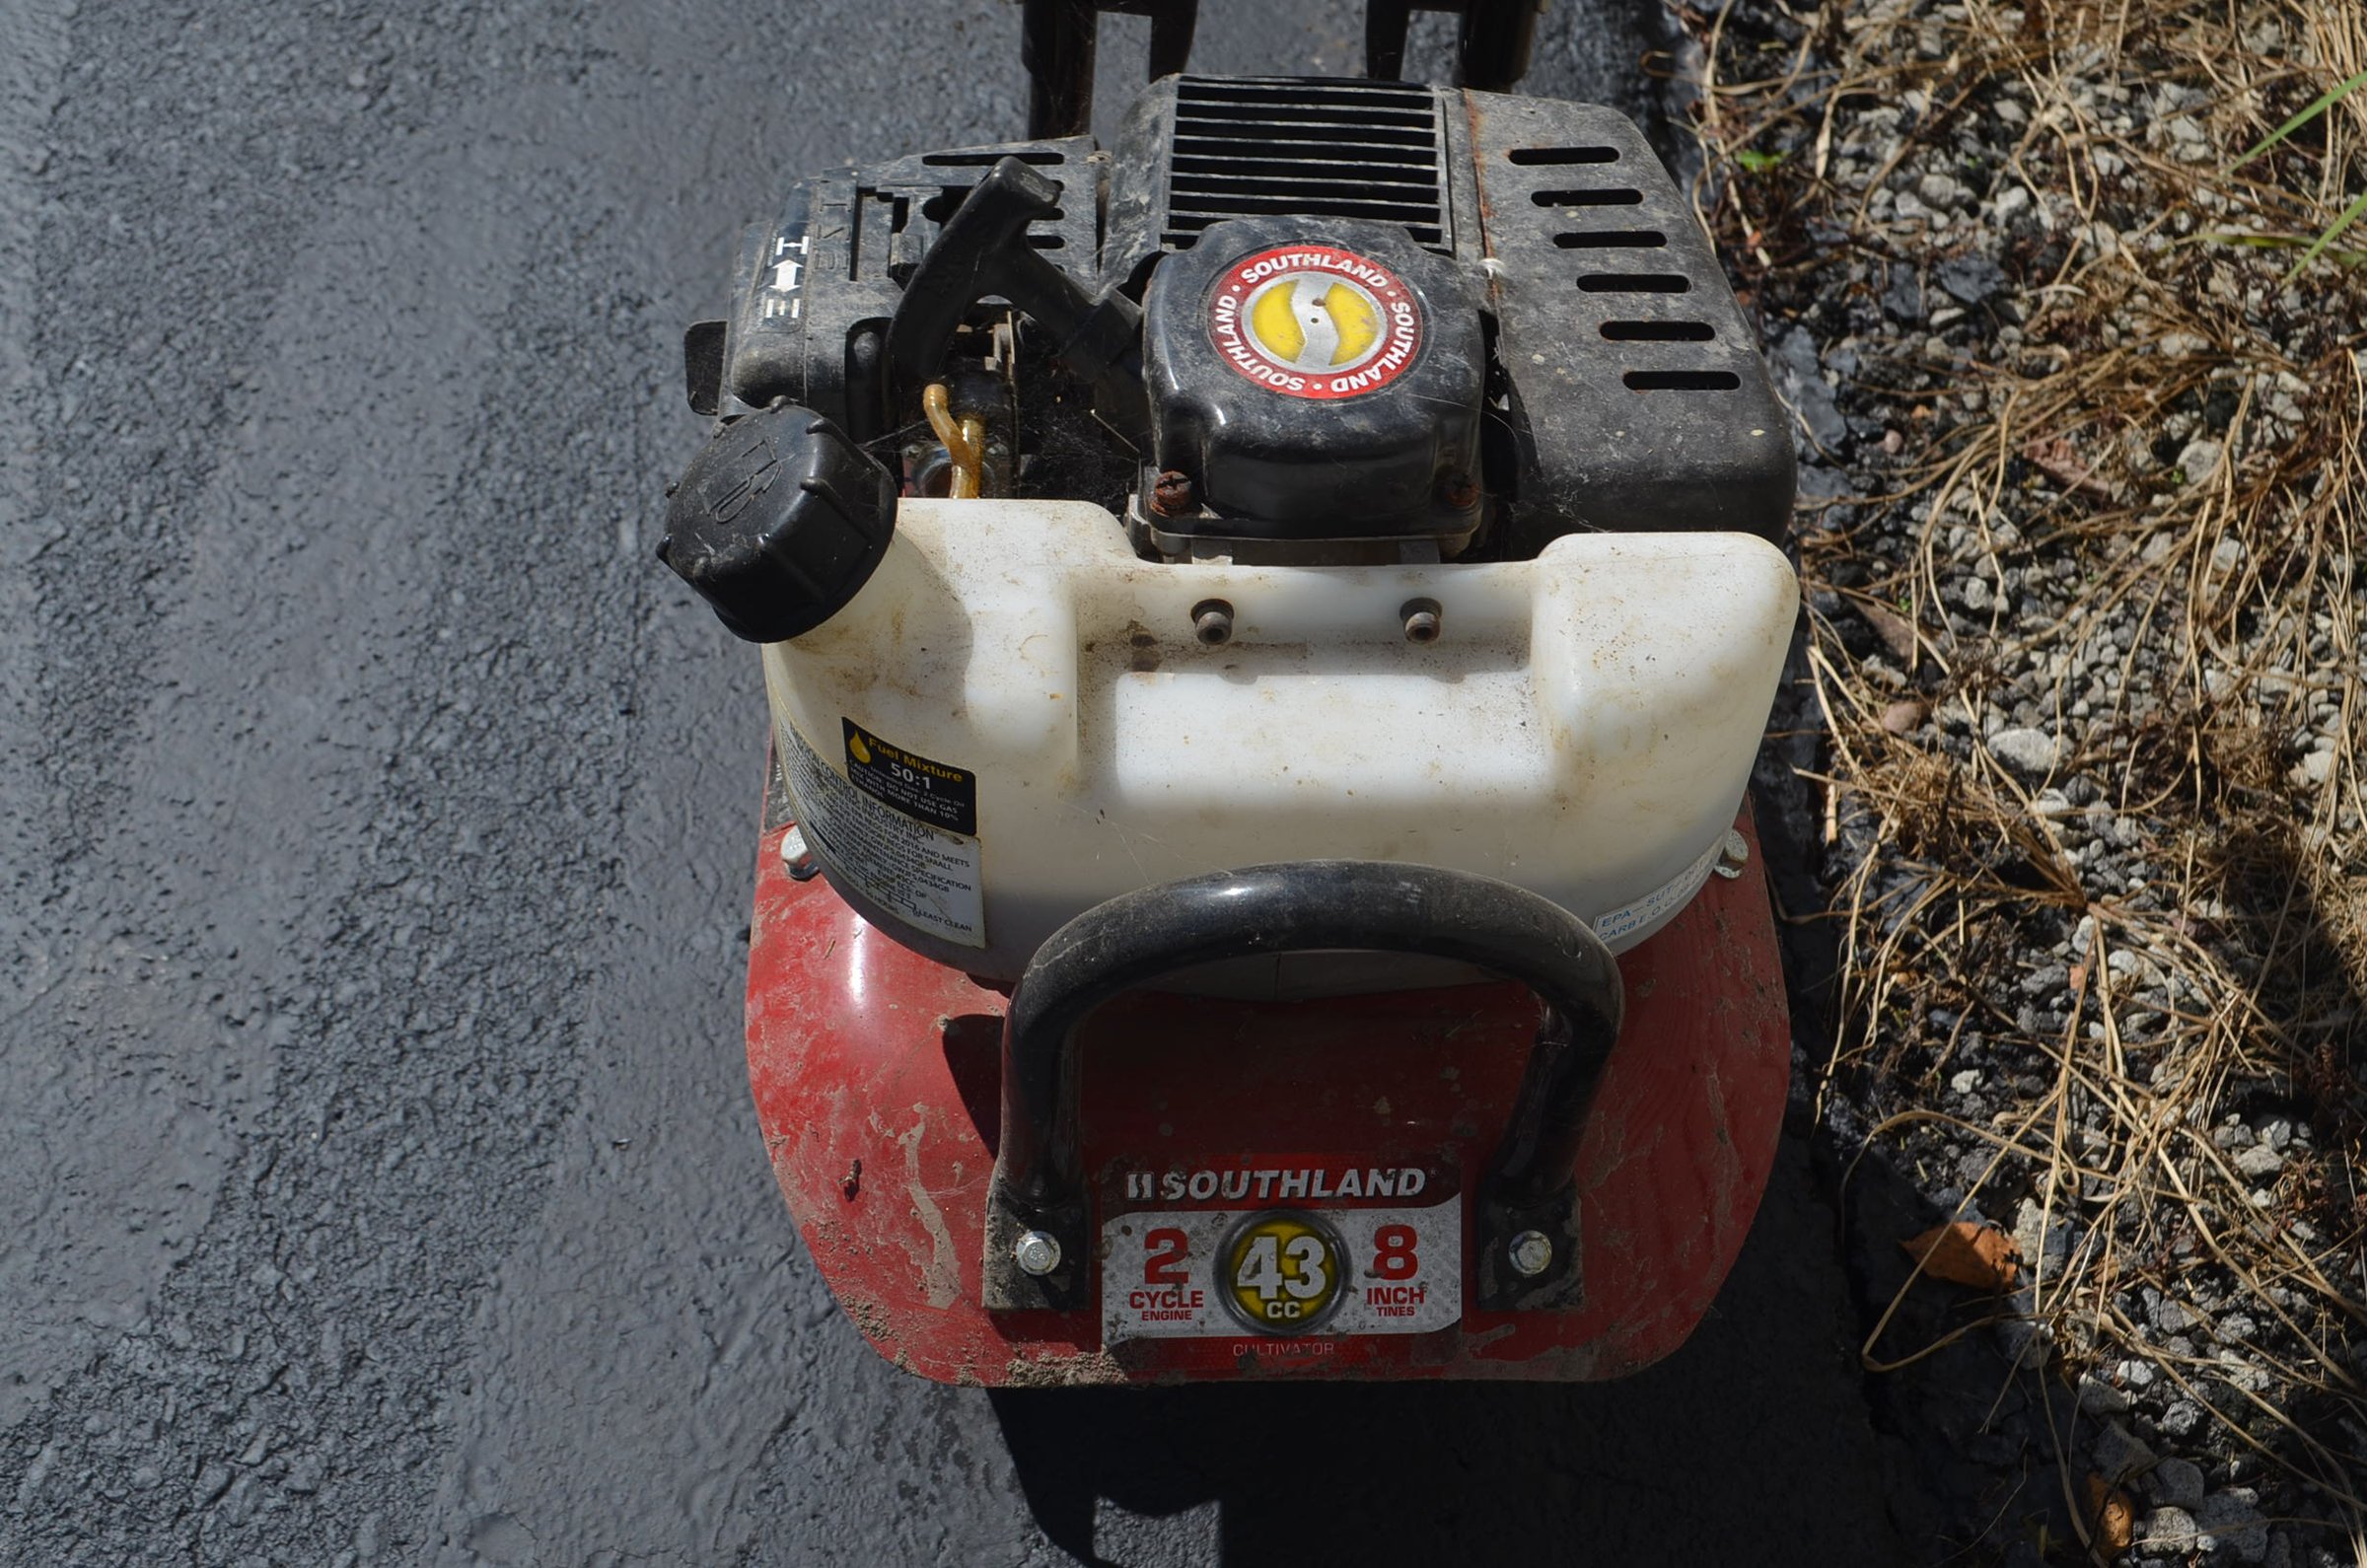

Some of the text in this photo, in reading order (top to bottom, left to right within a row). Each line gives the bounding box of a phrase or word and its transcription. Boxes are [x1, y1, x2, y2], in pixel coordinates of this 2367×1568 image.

[1242, 252, 1389, 288] SOUTHLAND
[1215, 295, 1306, 392] SOUTHLAND
[1330, 301, 1414, 392] SOUTHLAND
[868, 737, 964, 782] Fuel Mixture
[891, 761, 931, 790] 50:1
[888, 788, 910, 804] MORE
[913, 800, 937, 816] THAN
[900, 788, 918, 801] NOT
[920, 797, 937, 808] USE
[939, 804, 958, 815] GAS
[862, 794, 935, 841] INFORMATION
[921, 844, 940, 858] AND
[942, 854, 970, 868] MEETS
[911, 865, 971, 891] SPECIFICATION
[944, 918, 972, 932] CLEAN
[1599, 921, 1637, 941] CARB
[1602, 909, 1632, 927] EPA
[1161, 1168, 1427, 1201] SOUTHLAND
[1144, 1228, 1189, 1285] 2
[1372, 1224, 1419, 1281] 8
[1237, 1235, 1327, 1301] 43
[1128, 1289, 1204, 1310] CYCLE
[1366, 1286, 1425, 1306] INCH
[1141, 1309, 1193, 1321] ENGINE
[1376, 1305, 1415, 1318] TINES
[1233, 1342, 1334, 1358] CULTIVATOR
